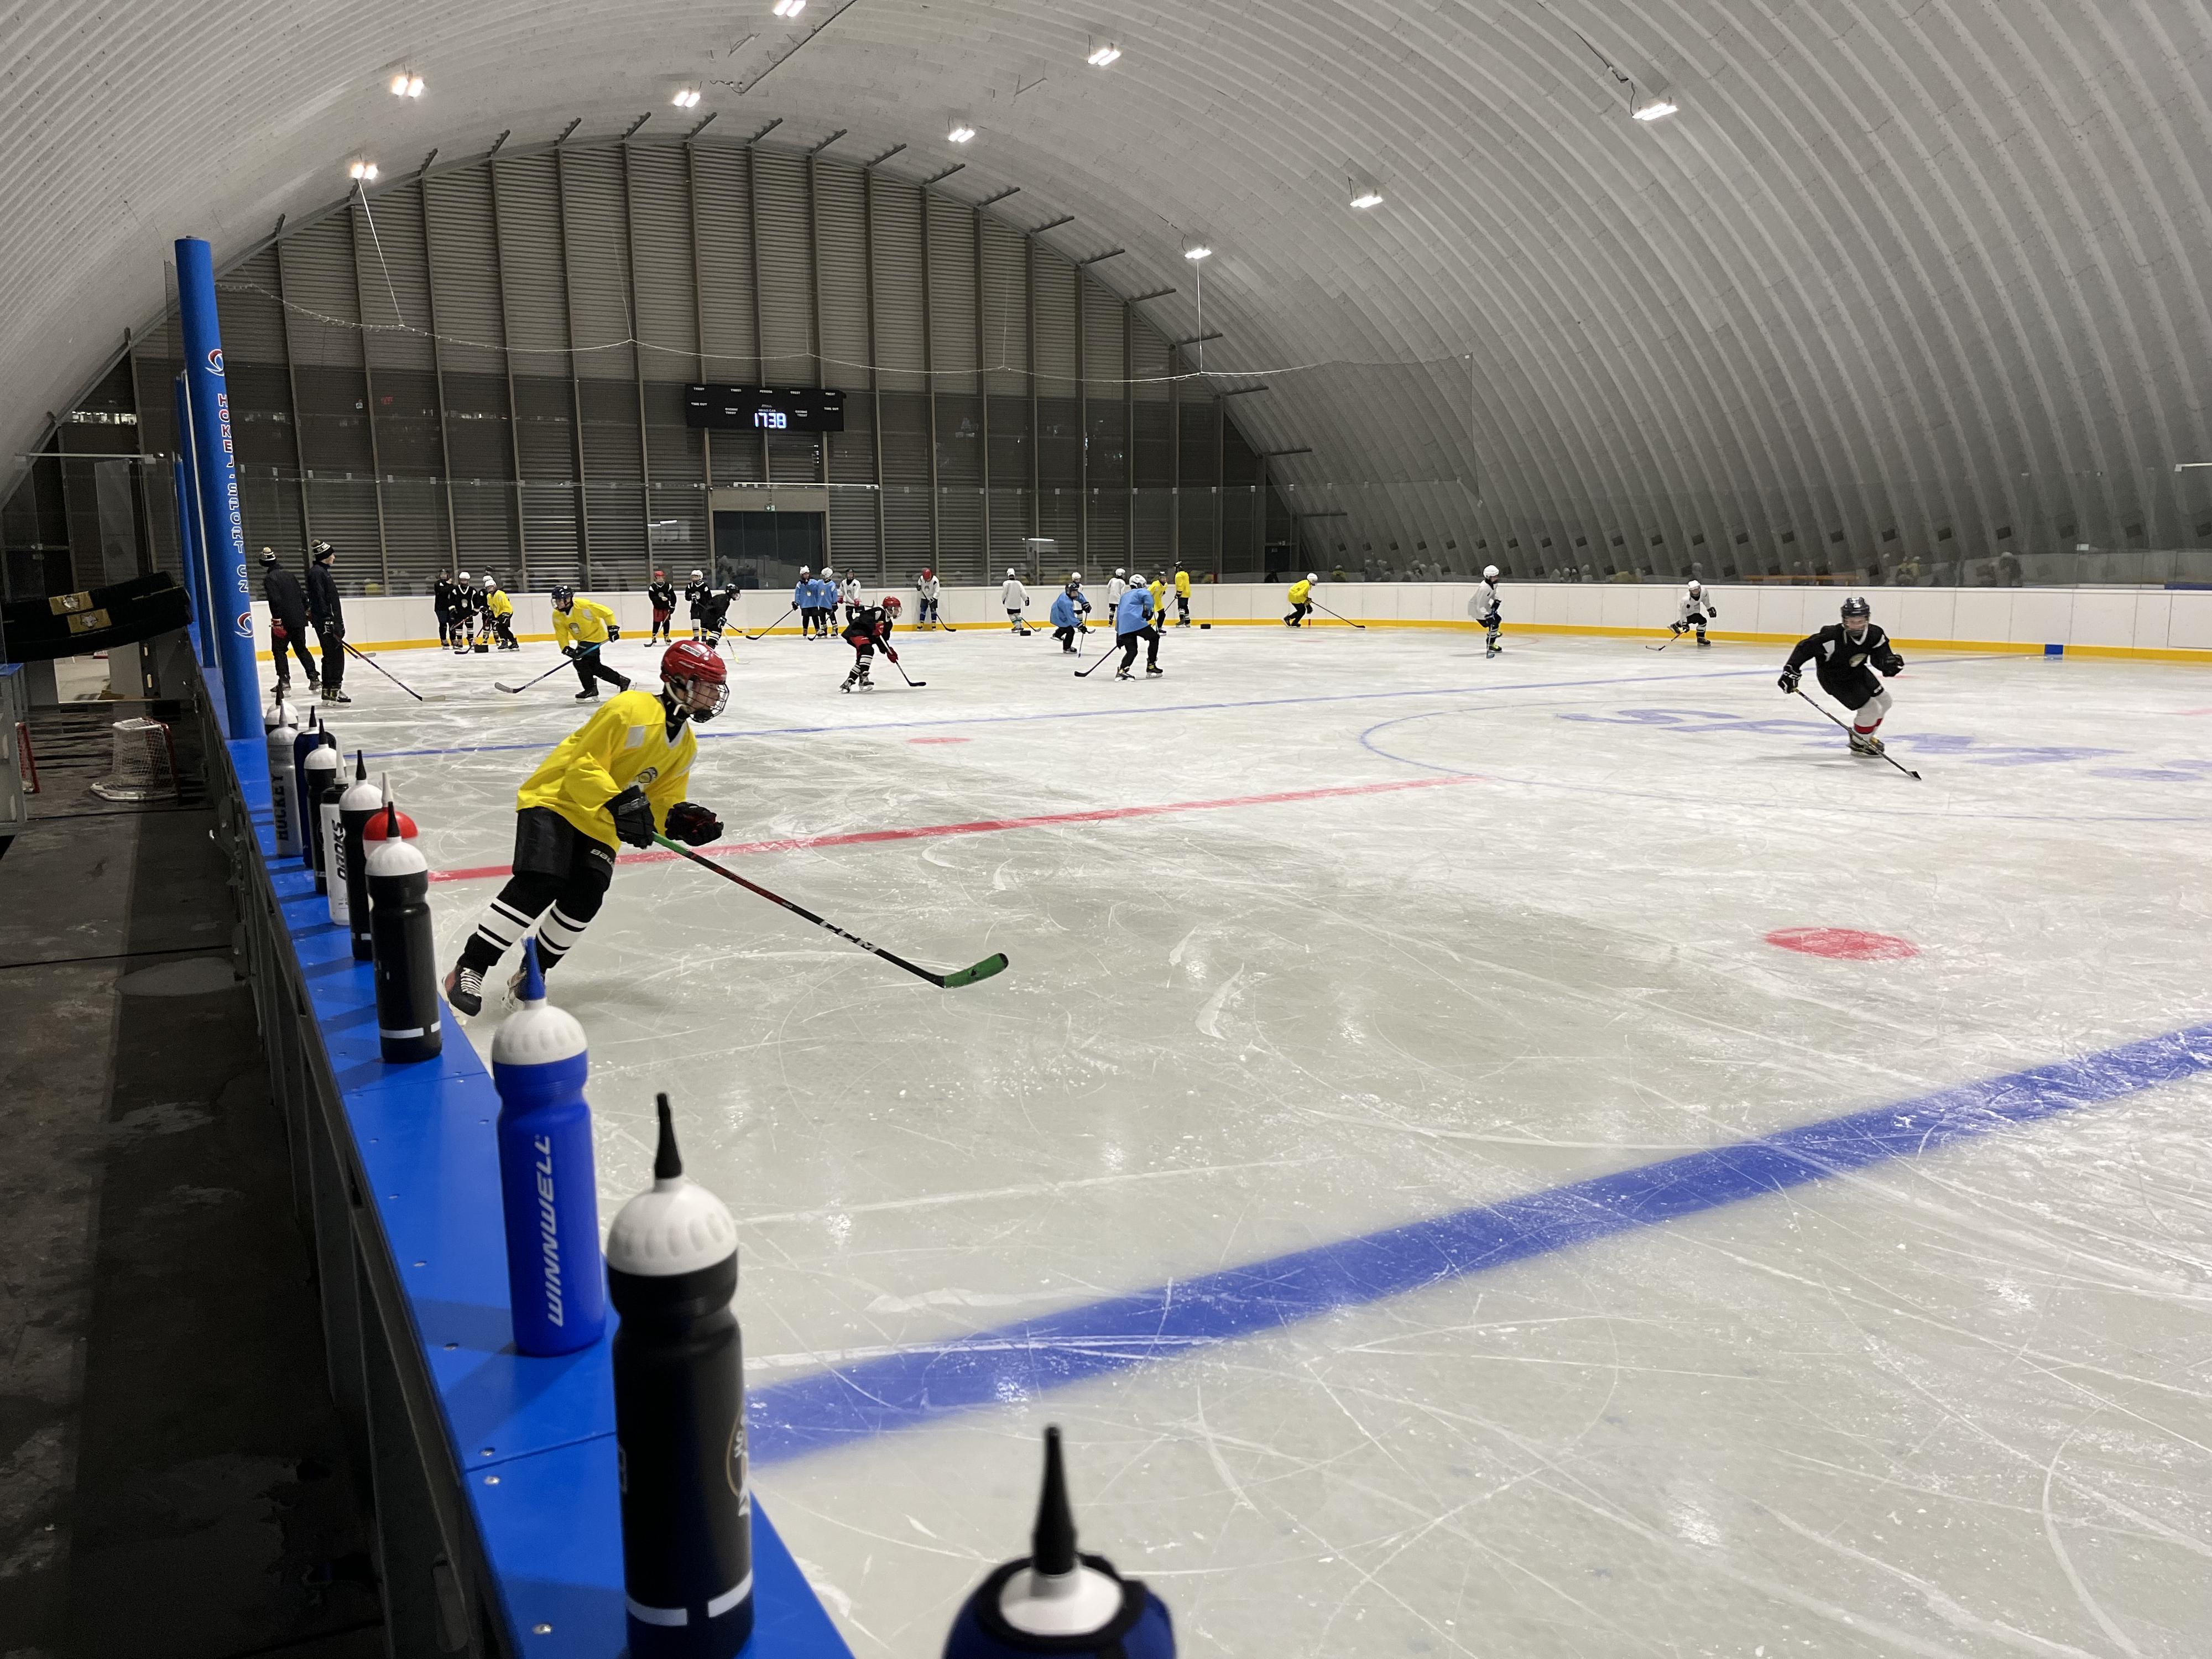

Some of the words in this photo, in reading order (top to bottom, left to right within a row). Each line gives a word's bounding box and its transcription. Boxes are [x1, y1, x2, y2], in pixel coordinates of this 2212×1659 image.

[271, 773, 288, 841] HOCKEY
[820, 921, 878, 952] CCM
[534, 1135, 563, 1327] WINNWELL
